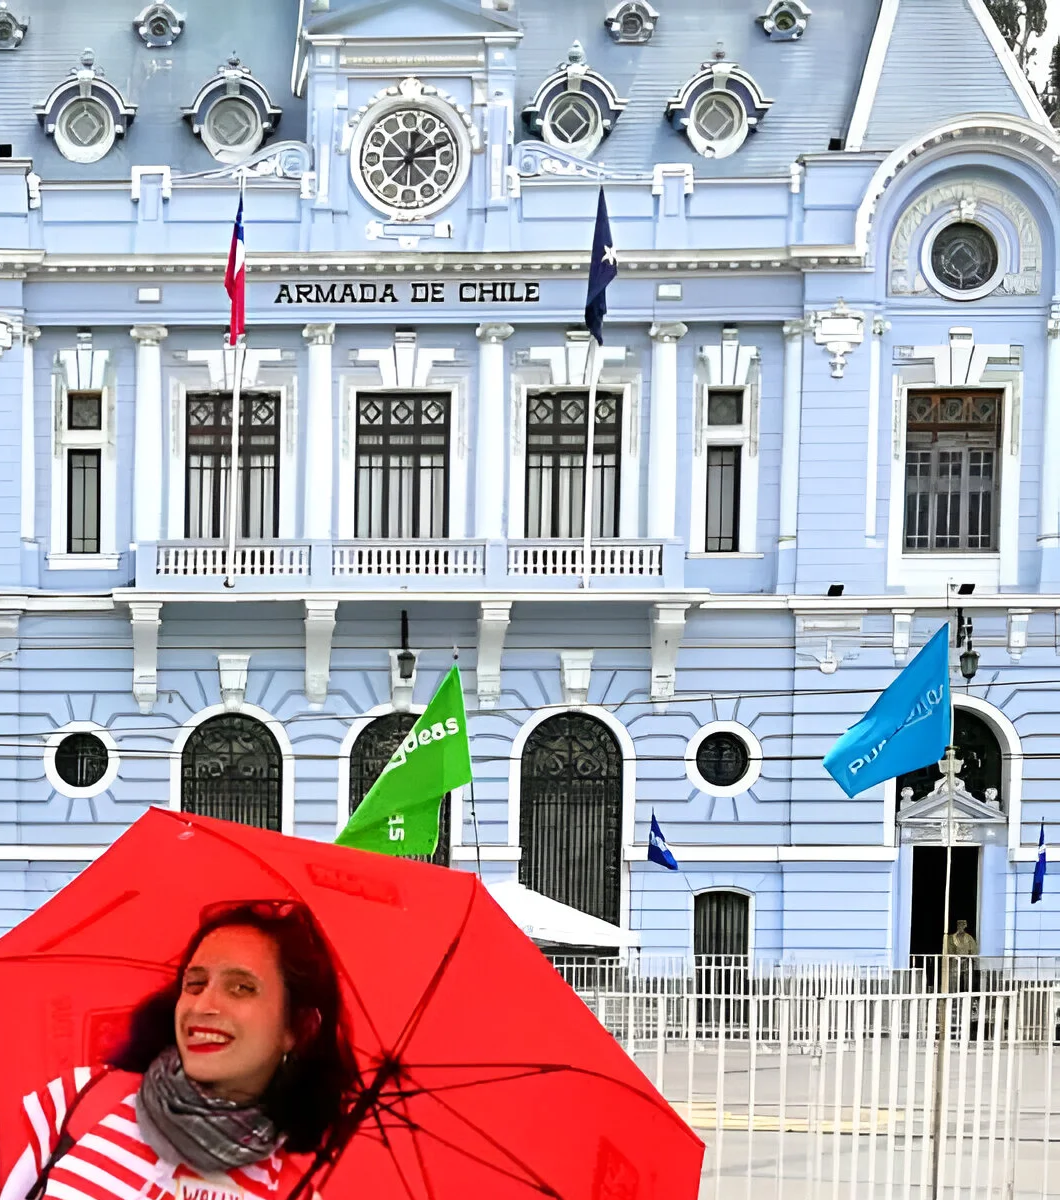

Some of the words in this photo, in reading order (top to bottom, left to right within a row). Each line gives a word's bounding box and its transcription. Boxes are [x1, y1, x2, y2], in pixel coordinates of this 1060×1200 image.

[274, 283, 399, 304] ARMADA
[410, 282, 445, 303] DE
[459, 281, 540, 303] CHILE
